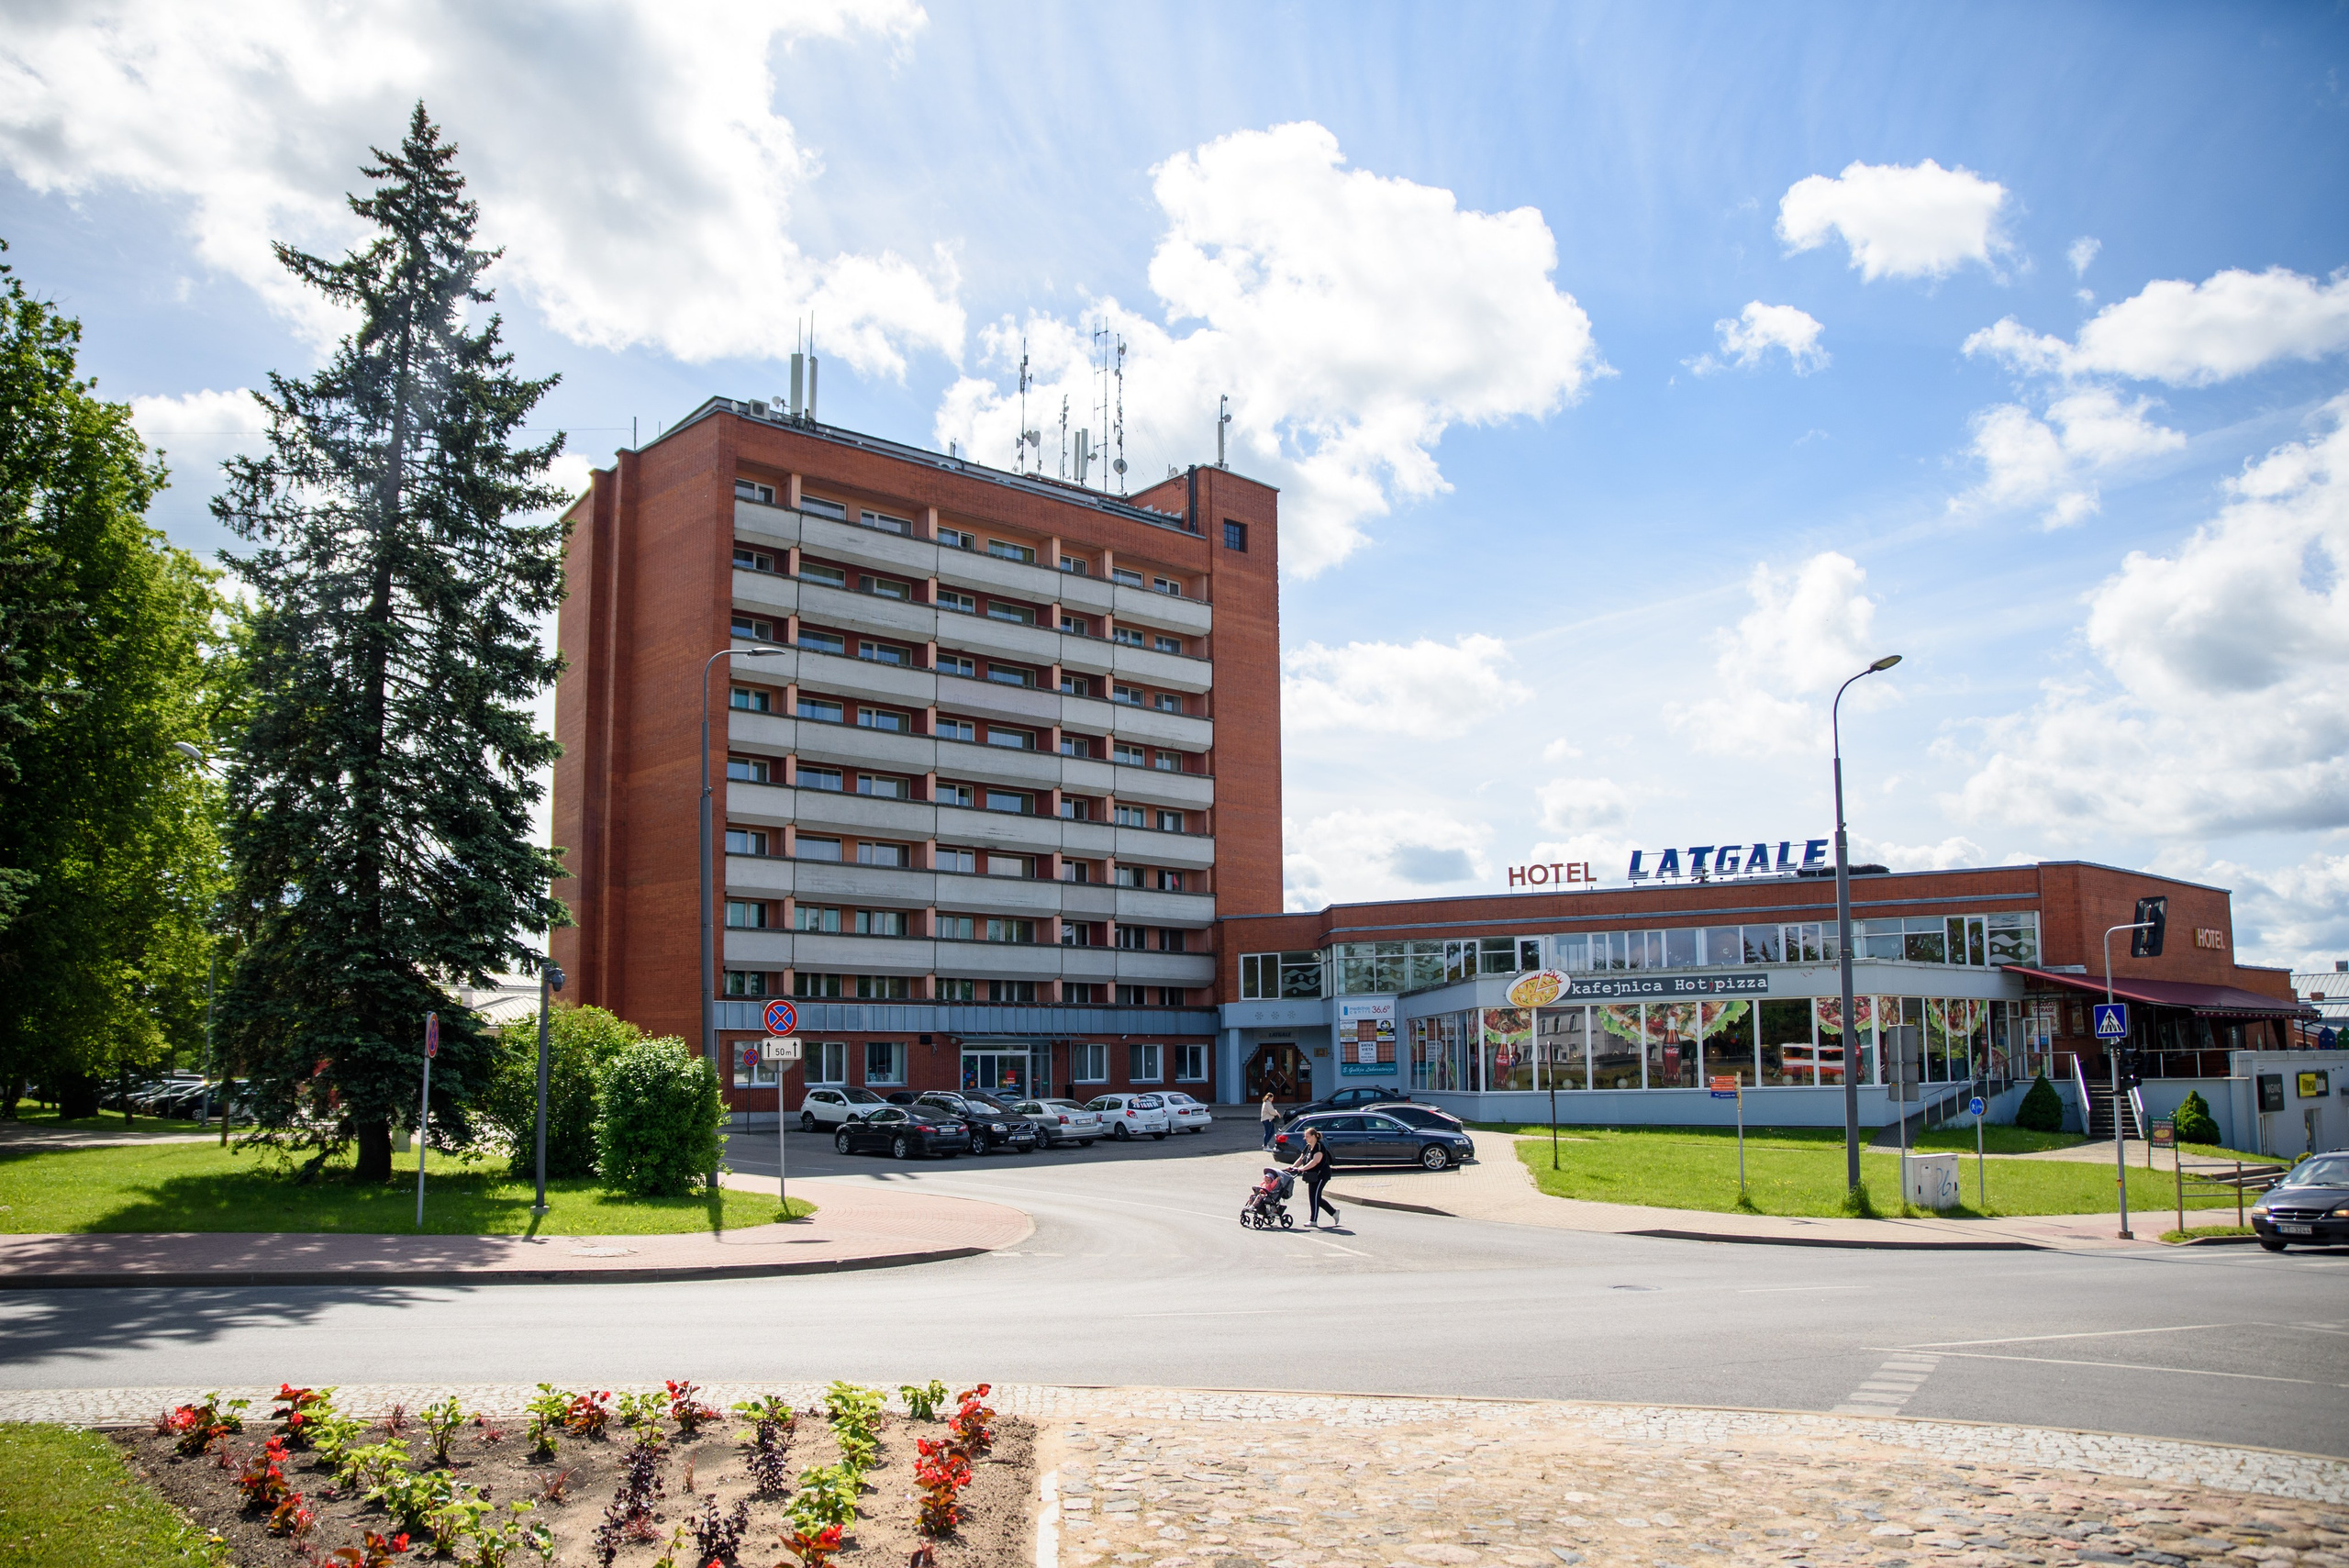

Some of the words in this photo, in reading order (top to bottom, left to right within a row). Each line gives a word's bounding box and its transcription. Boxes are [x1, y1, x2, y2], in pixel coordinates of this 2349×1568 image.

[1508, 862, 1598, 887] HOTEL
[1627, 839, 1830, 881] LATGALE
[2195, 928, 2226, 950] HOTEL
[1571, 981, 1664, 997] kafejnica
[1675, 979, 1708, 992] Hot
[1714, 977, 1768, 993] pizza
[774, 1048, 785, 1056] 50
